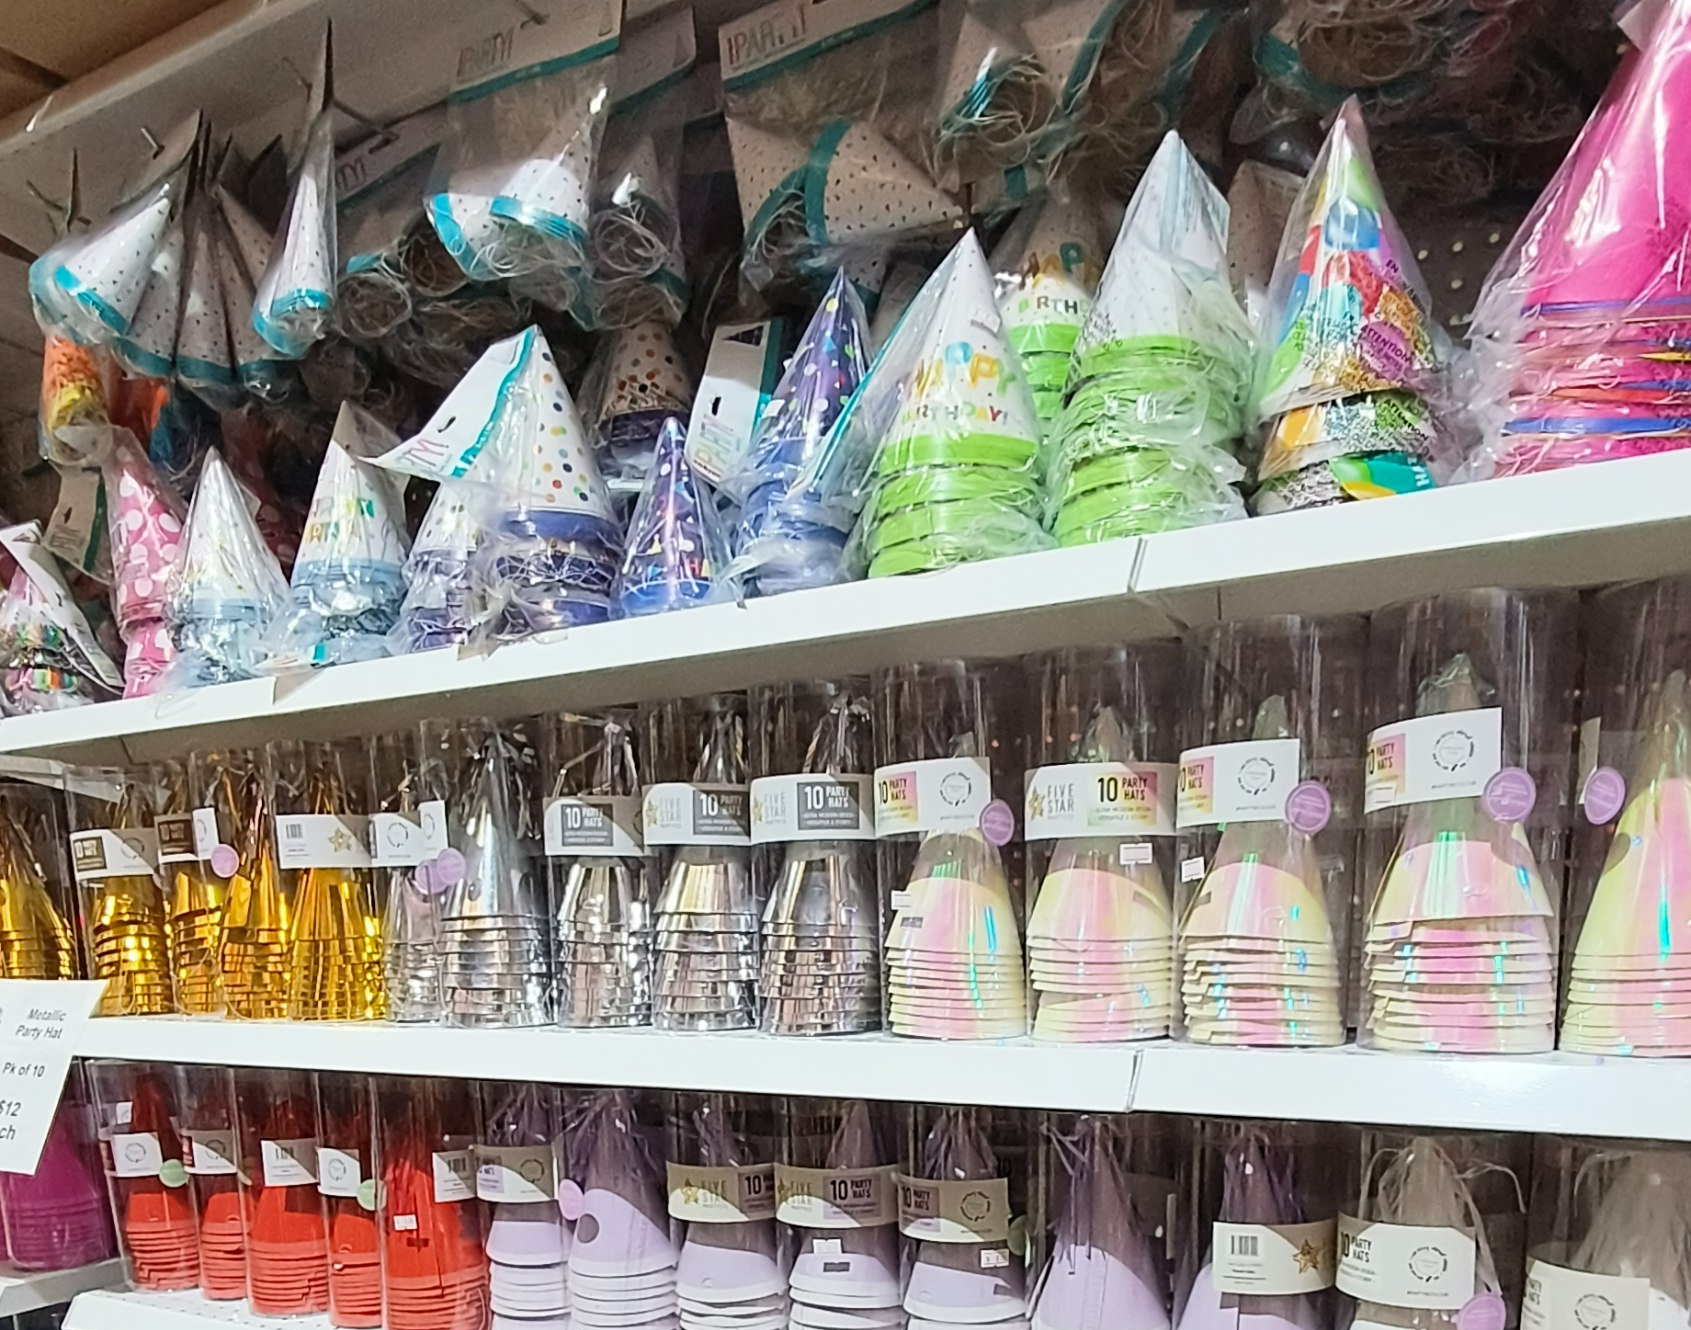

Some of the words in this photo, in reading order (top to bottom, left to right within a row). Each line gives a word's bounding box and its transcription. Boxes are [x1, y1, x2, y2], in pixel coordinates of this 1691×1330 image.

[889, 778, 908, 791] PARTY
[1097, 776, 1118, 803] 10
[1122, 777, 1148, 789] PARTY
[804, 785, 824, 810] 10
[825, 785, 850, 798] PARTY
[1047, 783, 1075, 799] FIVE
[1124, 789, 1146, 801] HATS
[699, 793, 719, 816] 10
[720, 793, 743, 806] PARTY
[764, 792, 787, 805] FIVE
[828, 797, 849, 809] HATS
[582, 806, 603, 818] PARTY
[764, 805, 787, 818] STAR
[1047, 798, 1075, 814] STAR
[565, 807, 581, 829] 10
[584, 816, 603, 828] HATS
[27, 1008, 66, 1022] Metallic
[15, 1025, 42, 1041] Party
[43, 1026, 63, 1039] Hat
[2, 1062, 17, 1075] Pk
[18, 1063, 32, 1076] of
[33, 1065, 46, 1078] 10
[745, 1175, 762, 1196] 10
[830, 1179, 848, 1200] 10
[850, 1178, 873, 1190] PARTY
[852, 1188, 872, 1200] HATS
[1351, 1235, 1373, 1251] PARTY
[1352, 1249, 1371, 1263] HATS
